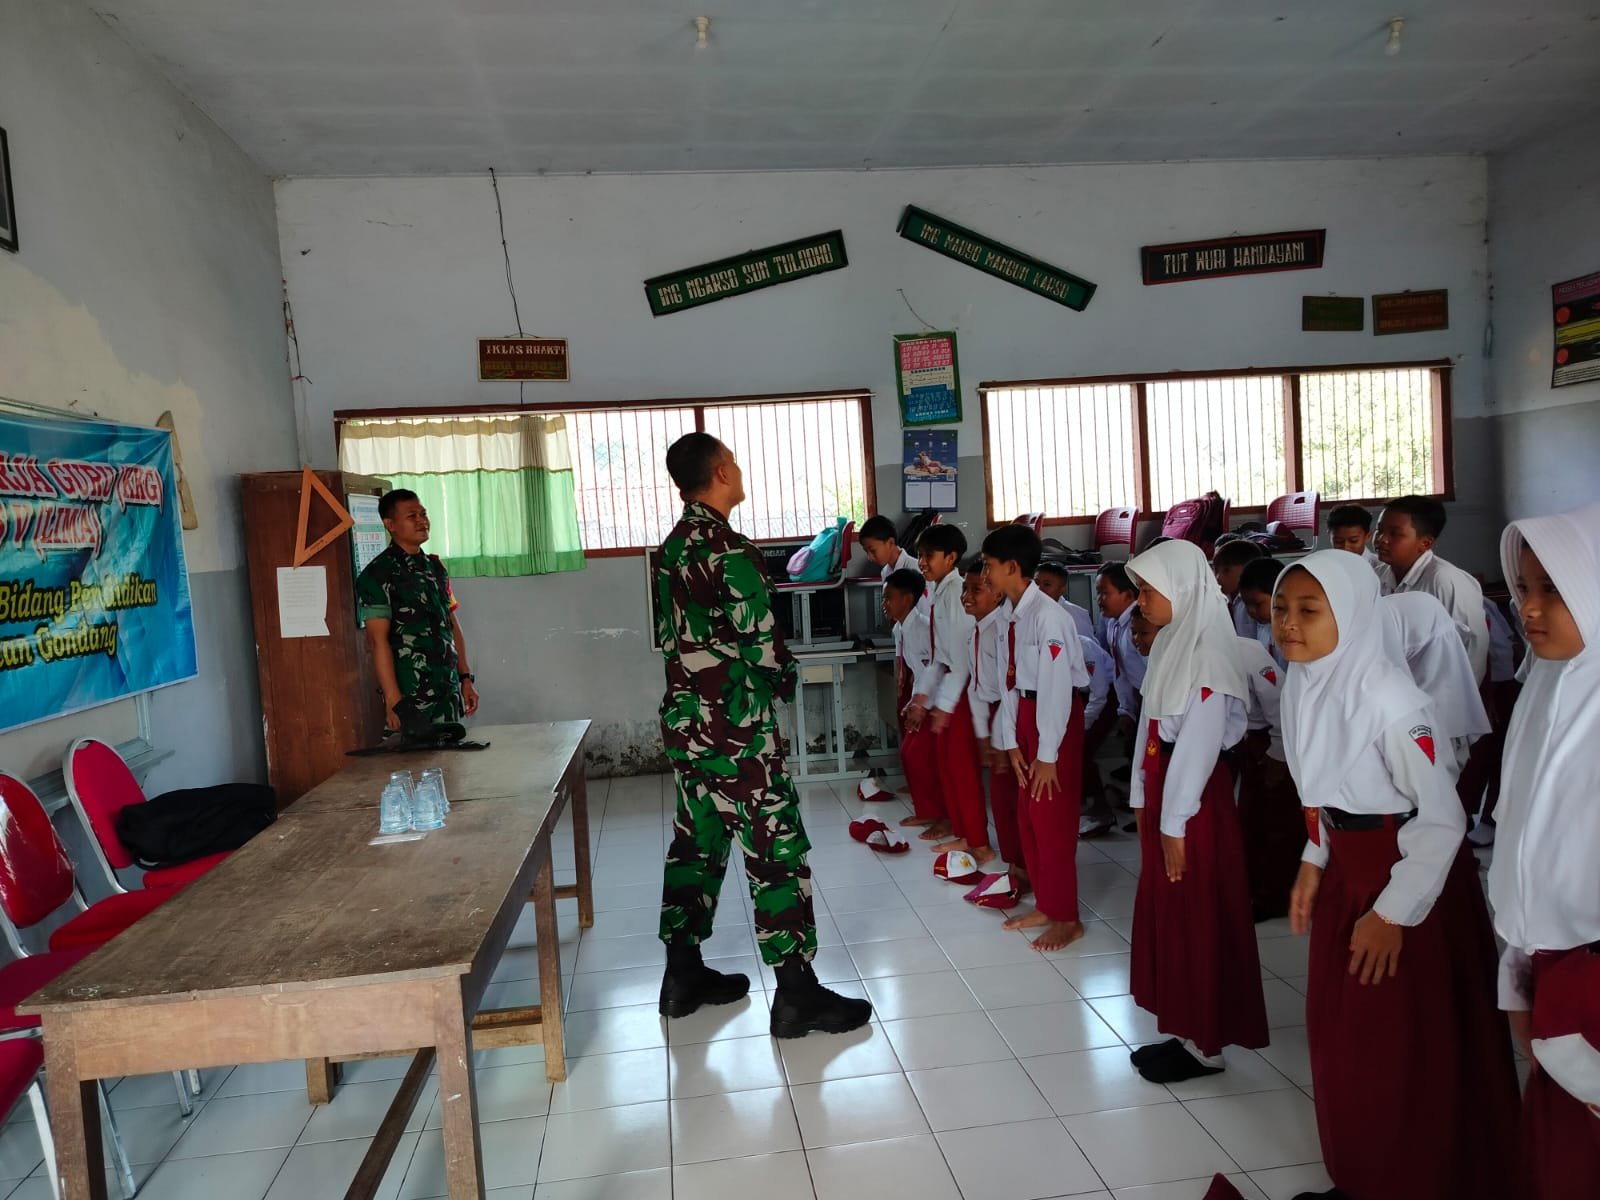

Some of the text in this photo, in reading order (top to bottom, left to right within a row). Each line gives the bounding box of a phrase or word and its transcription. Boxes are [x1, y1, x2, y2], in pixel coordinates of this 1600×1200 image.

[657, 242, 834, 307] ING NGARSO SUN TULODHO
[920, 223, 1070, 299] ING MADYO MANGUN KARSO
[1164, 242, 1305, 275] TUT WURI HANDAYANI
[48, 460, 116, 499] GURU
[33, 504, 101, 560] (LIMA)
[0, 582, 64, 624] Bidang
[35, 617, 117, 661] Gondang
